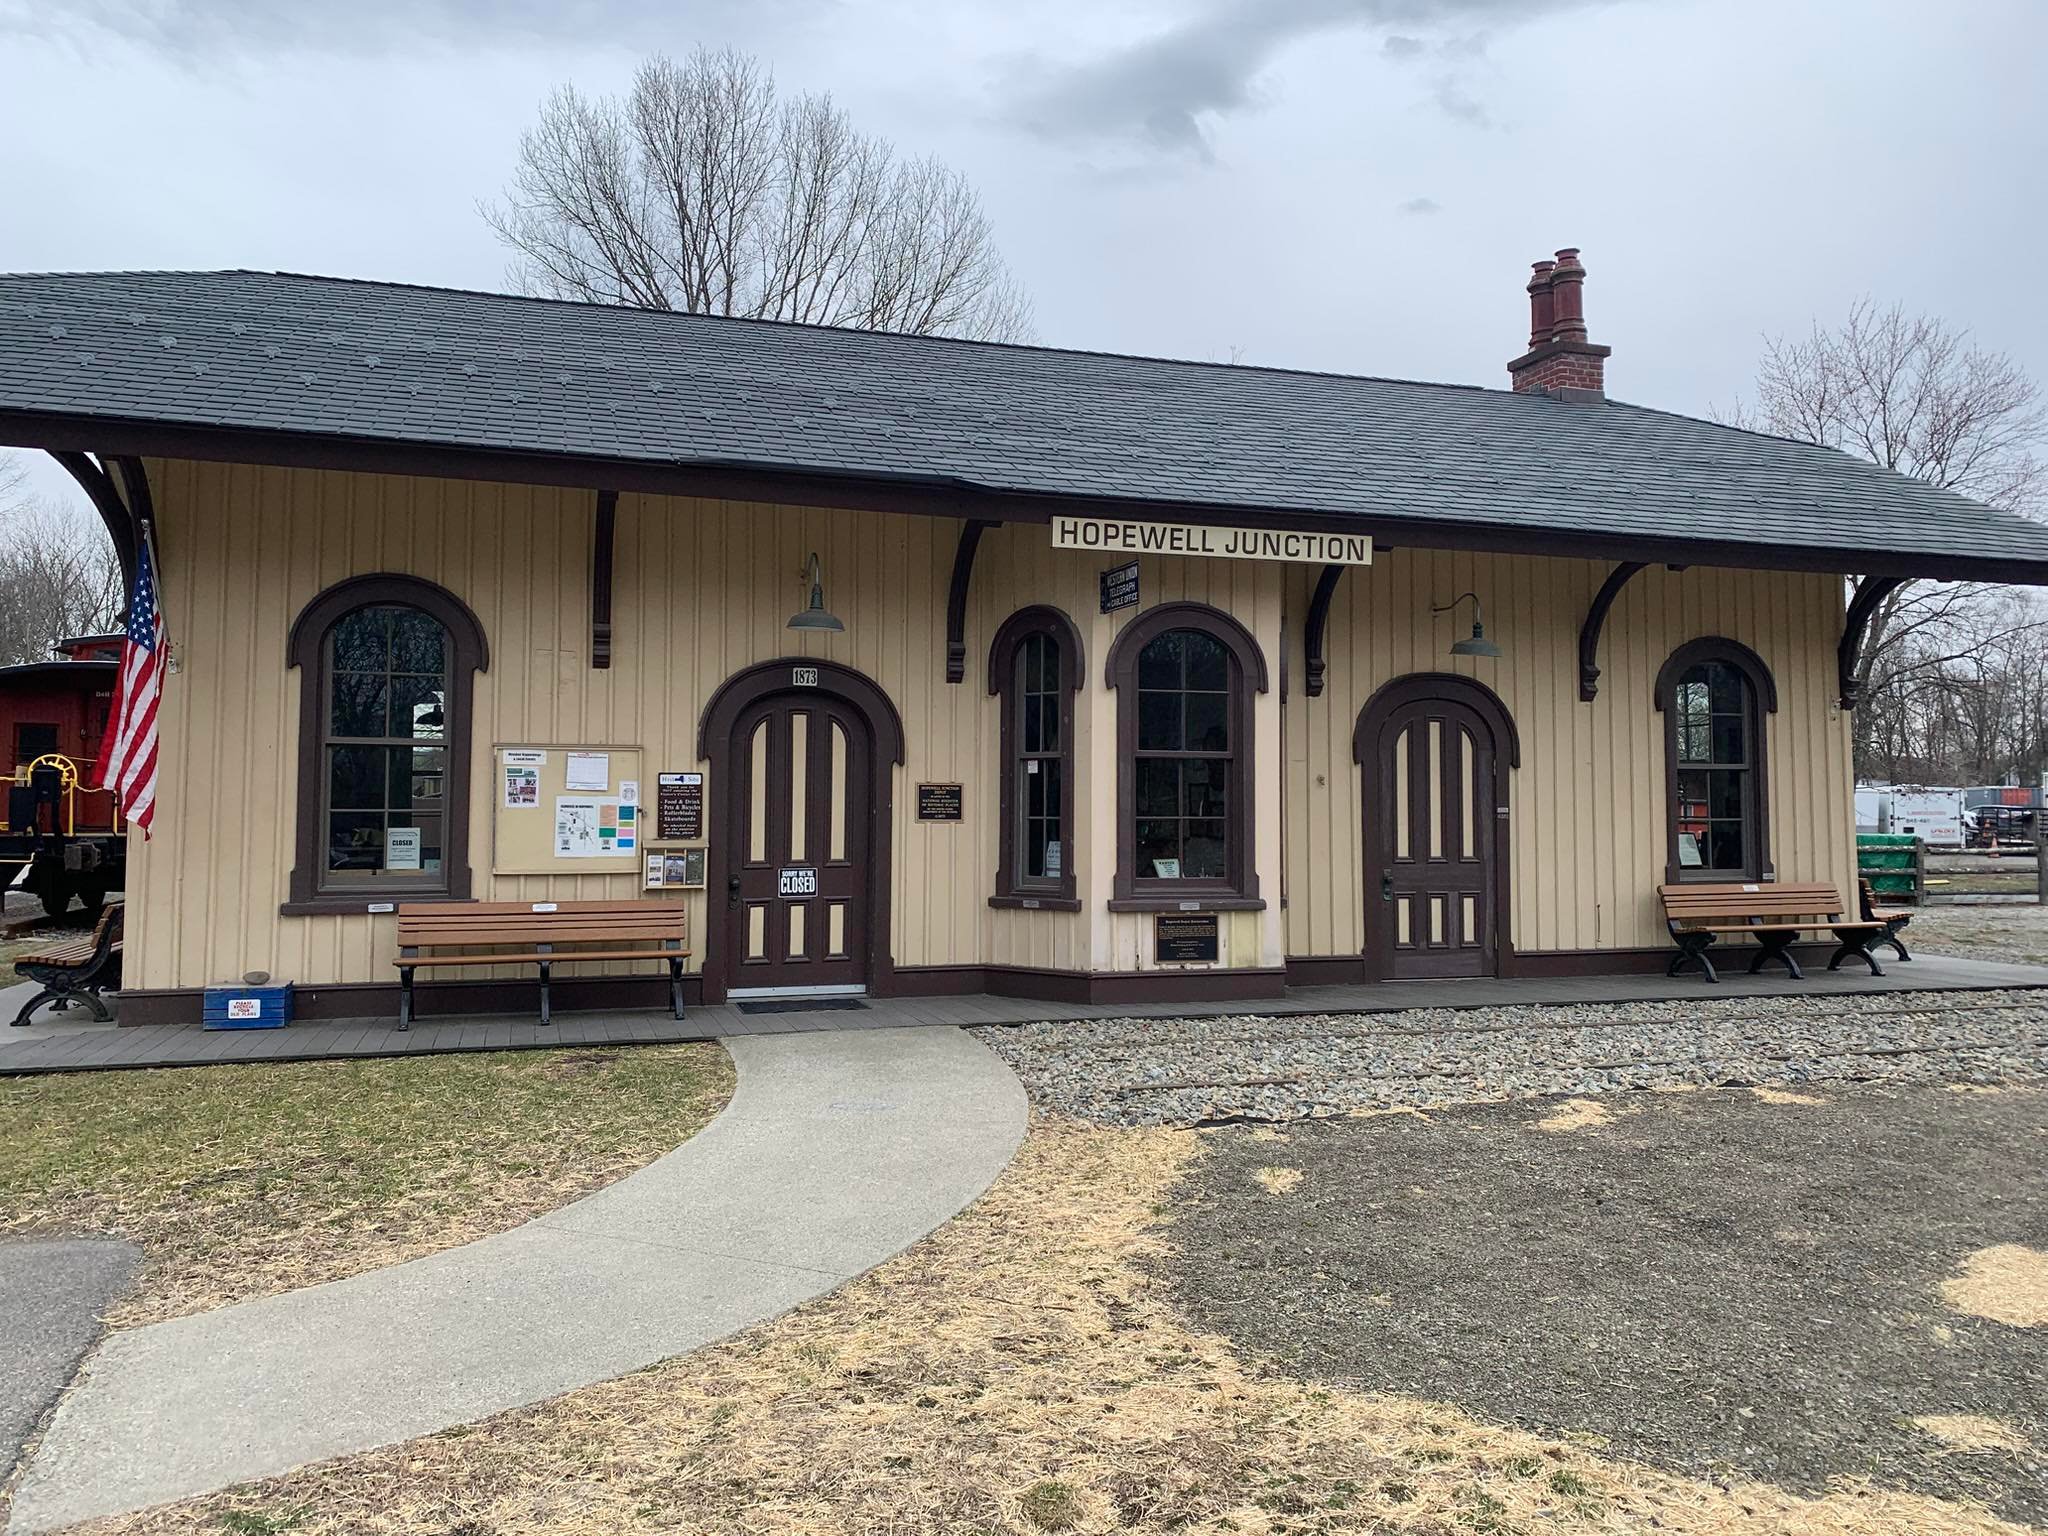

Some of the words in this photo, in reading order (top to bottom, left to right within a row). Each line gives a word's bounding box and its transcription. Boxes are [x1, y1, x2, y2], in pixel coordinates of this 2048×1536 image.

[1060, 520, 1215, 553] HOPEWELL
[1225, 531, 1365, 561] JUNCTION
[1126, 565, 1138, 580] UNION
[1109, 581, 1136, 597] TELEGRAPH
[1124, 592, 1138, 603] OFFICE
[794, 669, 817, 685] 1873
[780, 876, 816, 893] CLOSED
